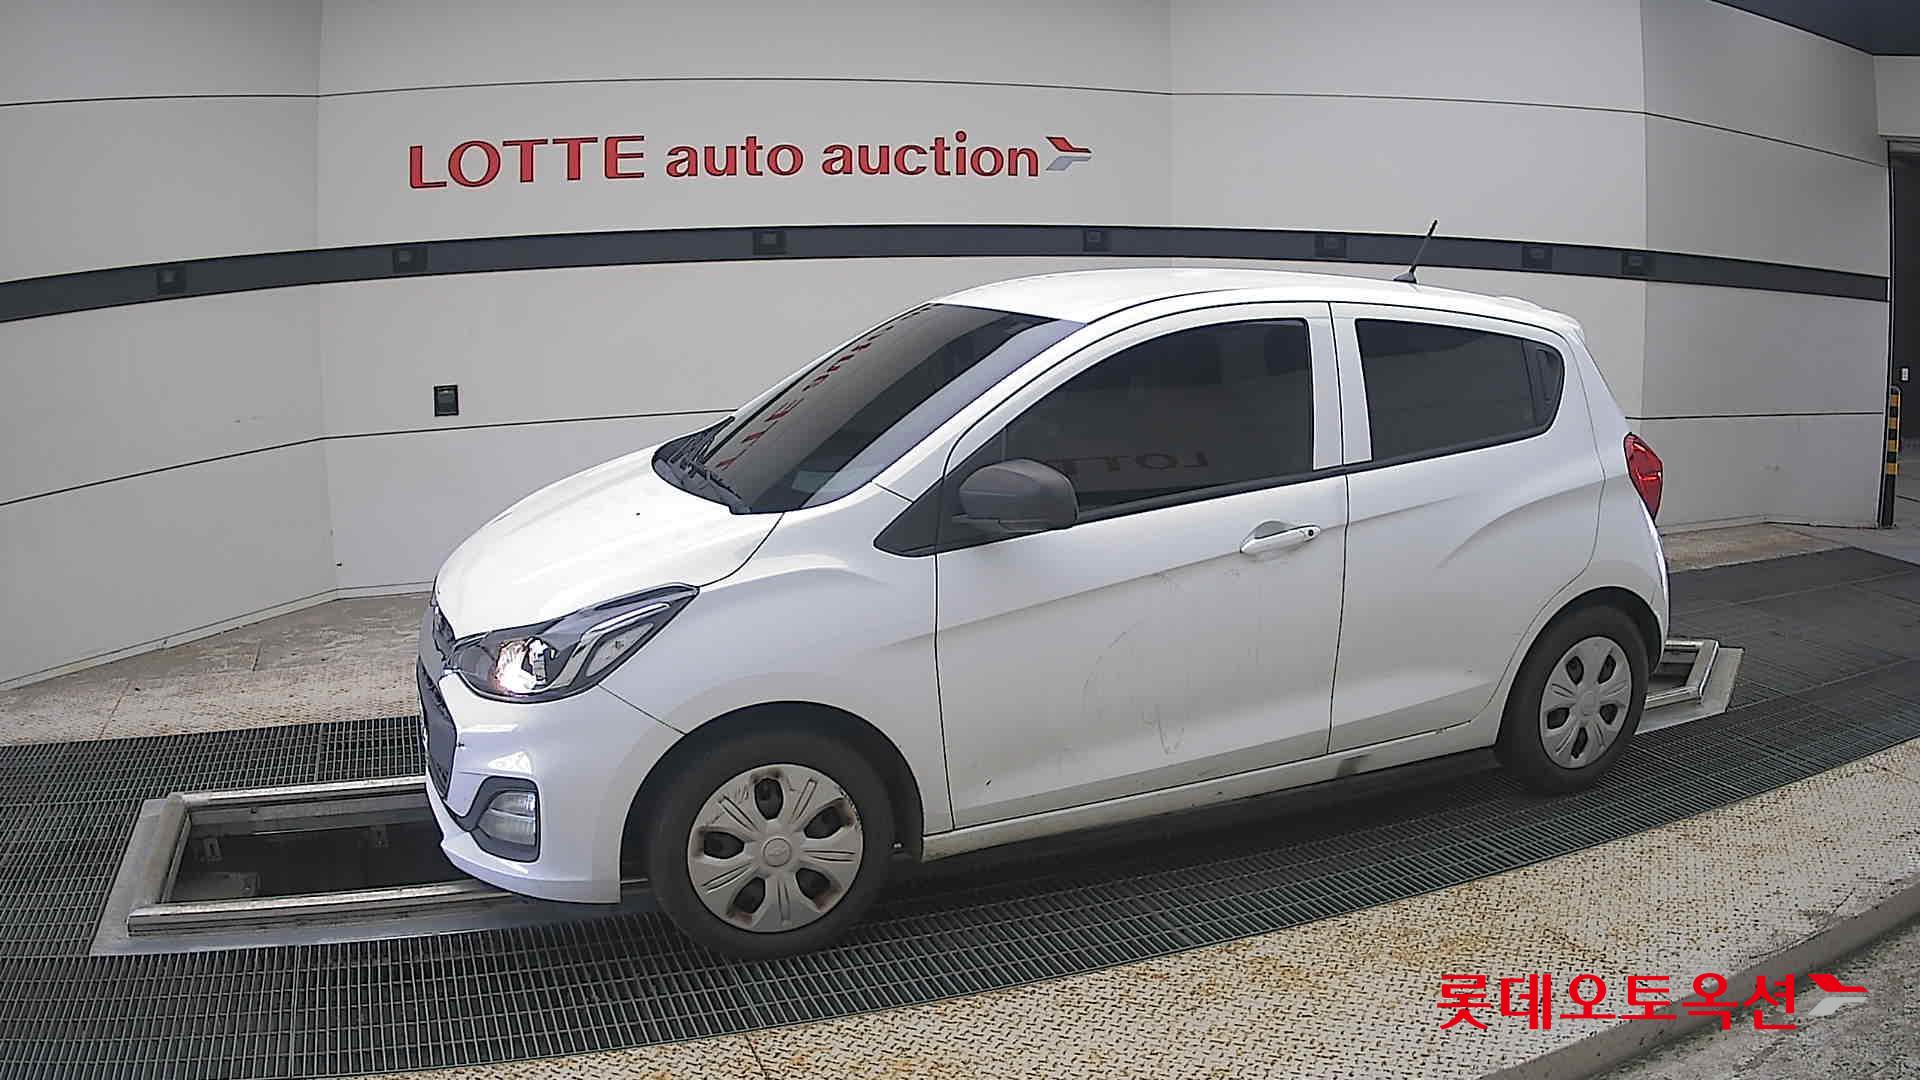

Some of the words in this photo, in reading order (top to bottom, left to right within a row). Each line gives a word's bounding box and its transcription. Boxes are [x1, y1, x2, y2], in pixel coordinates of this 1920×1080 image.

[408, 135, 646, 189] LOTTE
[665, 136, 804, 178] auto
[820, 130, 1040, 177] auction
